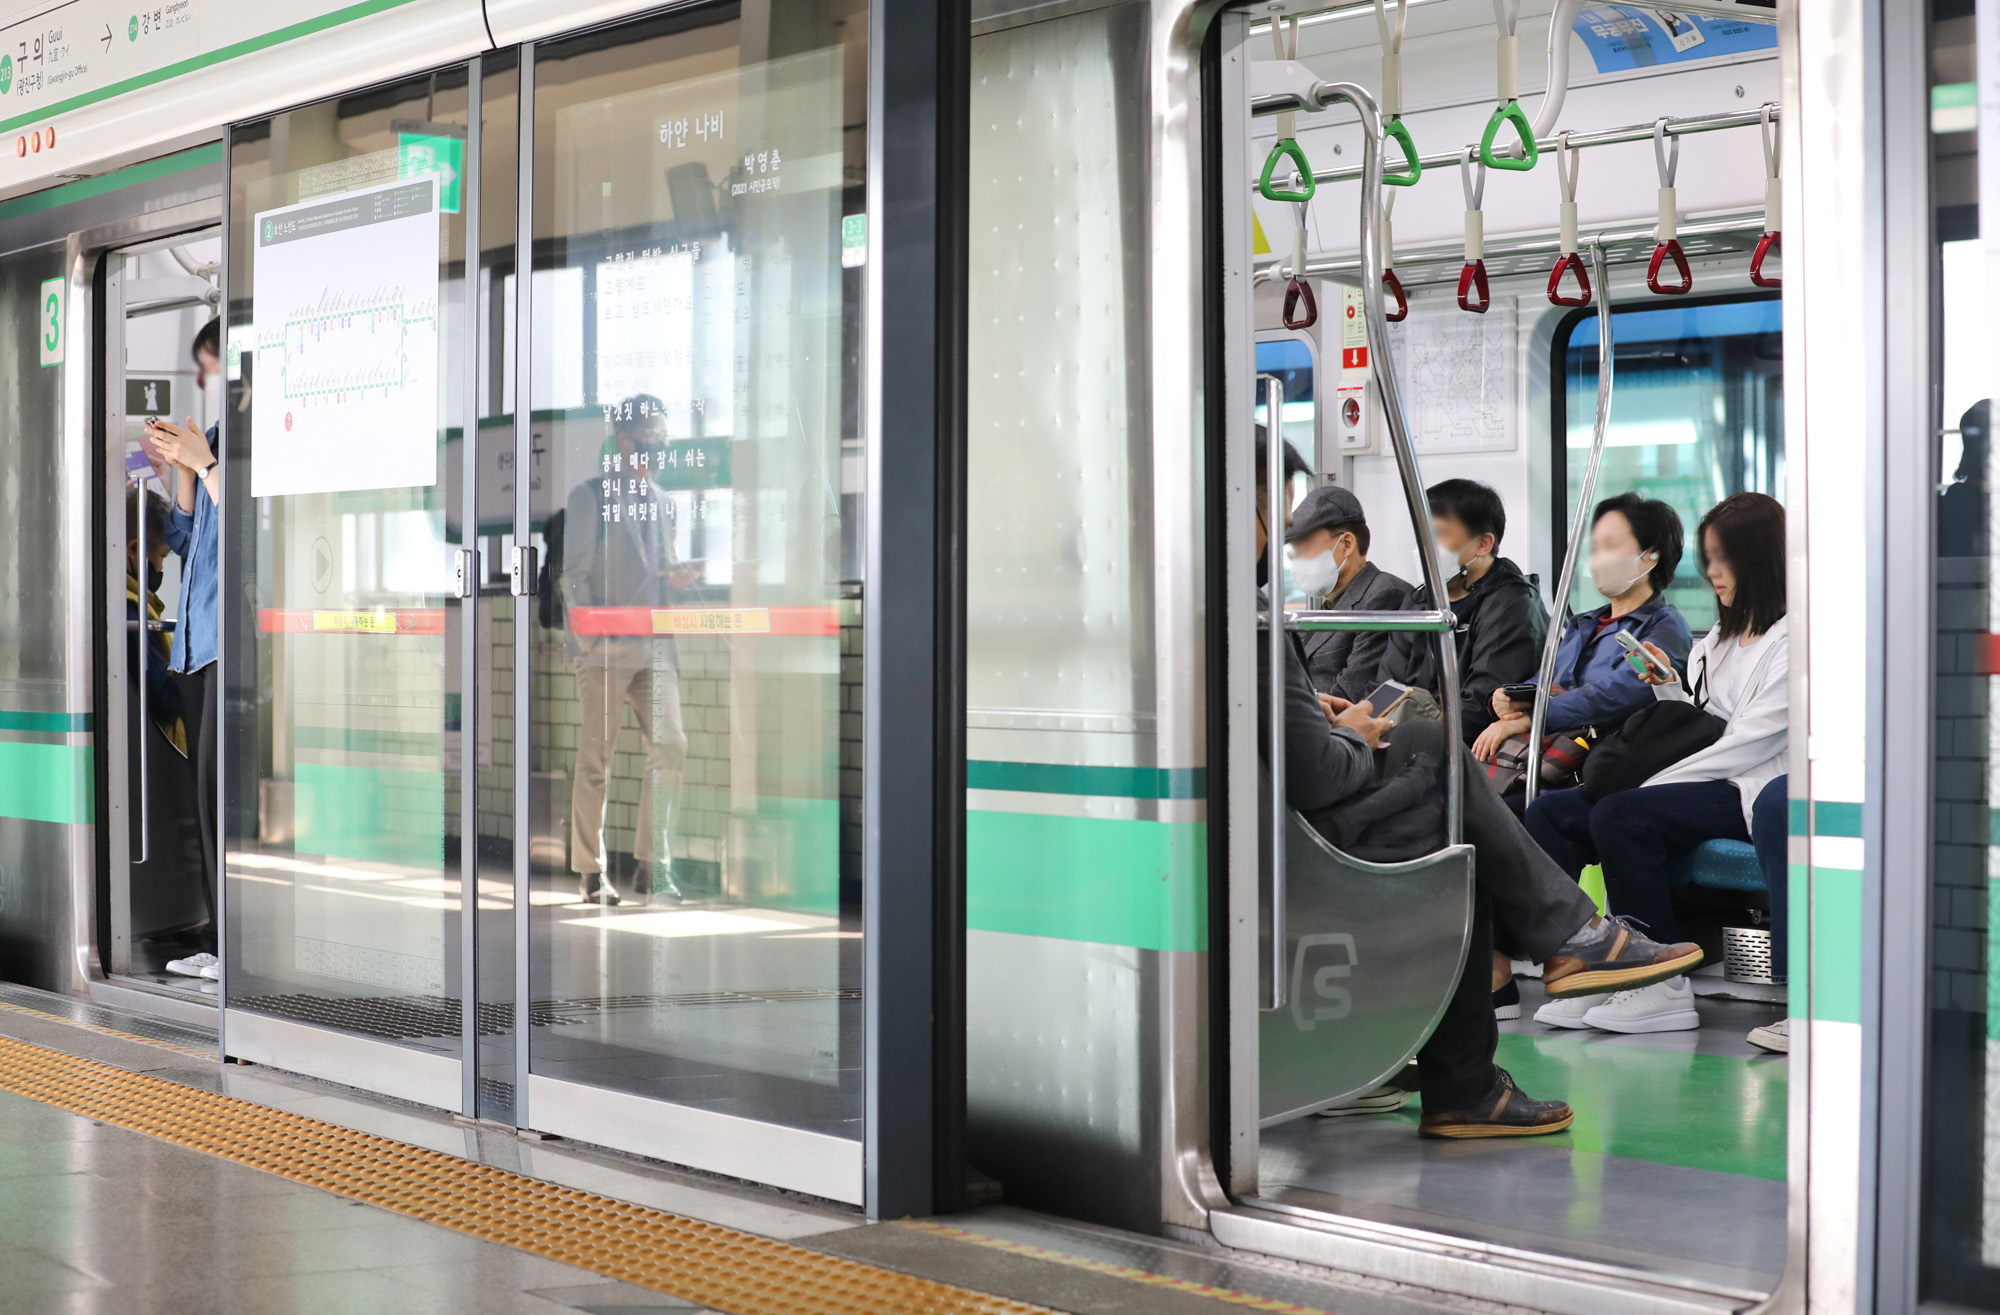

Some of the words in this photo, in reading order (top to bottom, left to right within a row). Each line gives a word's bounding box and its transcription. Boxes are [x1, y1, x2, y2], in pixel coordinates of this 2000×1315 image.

[165, 0, 189, 14] Gangbyeon
[142, 8, 161, 35] 강변
[48, 26, 63, 44] Guui
[17, 33, 44, 74] 구의
[1, 66, 12, 81] 213
[17, 71, 43, 96] (광진구청)
[659, 118, 689, 149] 하얀
[695, 110, 723, 142] 나비
[731, 183, 748, 197] (2021
[45, 292, 59, 352] 3
[602, 453, 622, 473] 콩밭
[629, 451, 650, 471] 매다
[657, 449, 677, 470] 잠시
[685, 448, 706, 468] 쉬는
[602, 478, 621, 498] 엄니
[628, 476, 649, 497] 모습
[602, 503, 621, 522] 귀밑
[628, 501, 658, 521] 머릿결
[673, 614, 697, 629] 비상시
[700, 614, 732, 629] 사용하는
[734, 613, 743, 628] 문
